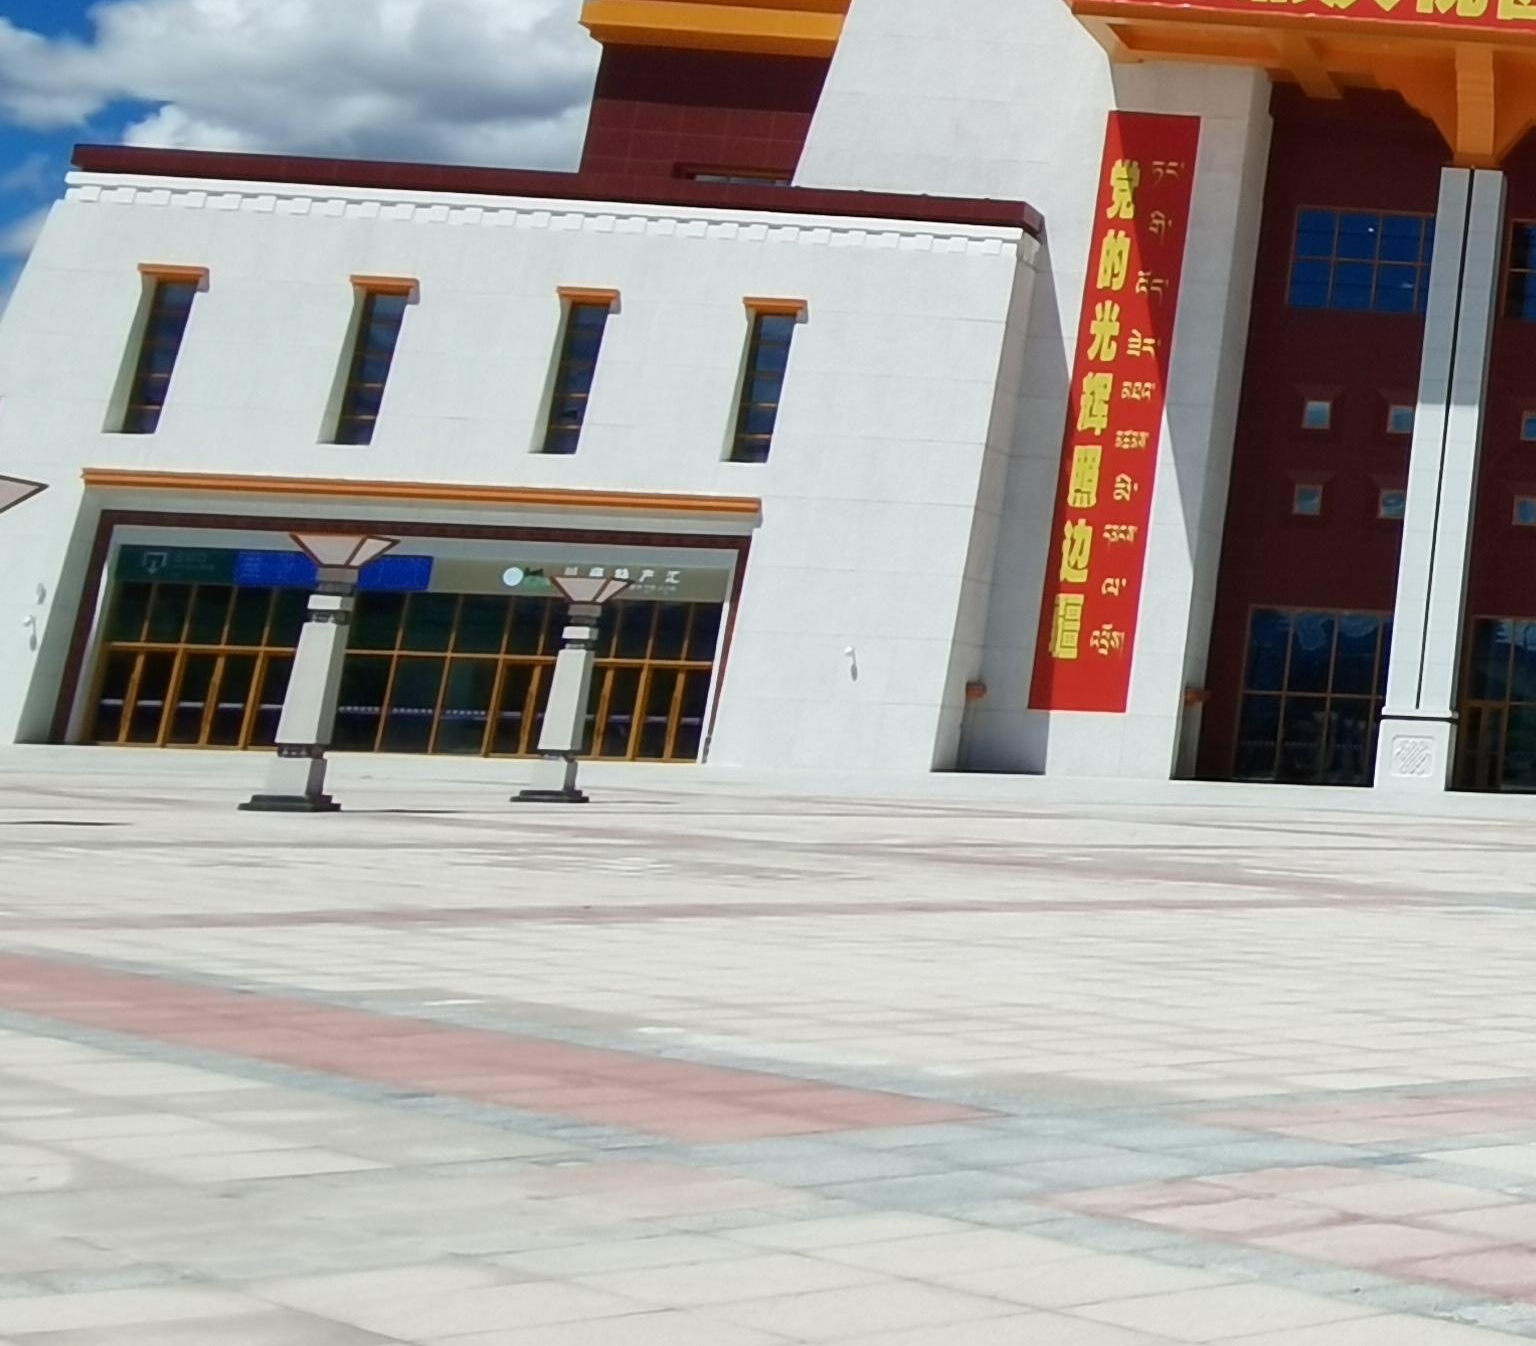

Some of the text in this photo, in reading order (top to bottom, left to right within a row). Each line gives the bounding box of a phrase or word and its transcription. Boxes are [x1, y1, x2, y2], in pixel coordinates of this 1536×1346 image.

[1049, 158, 1142, 660] 党的光辉照边疆
